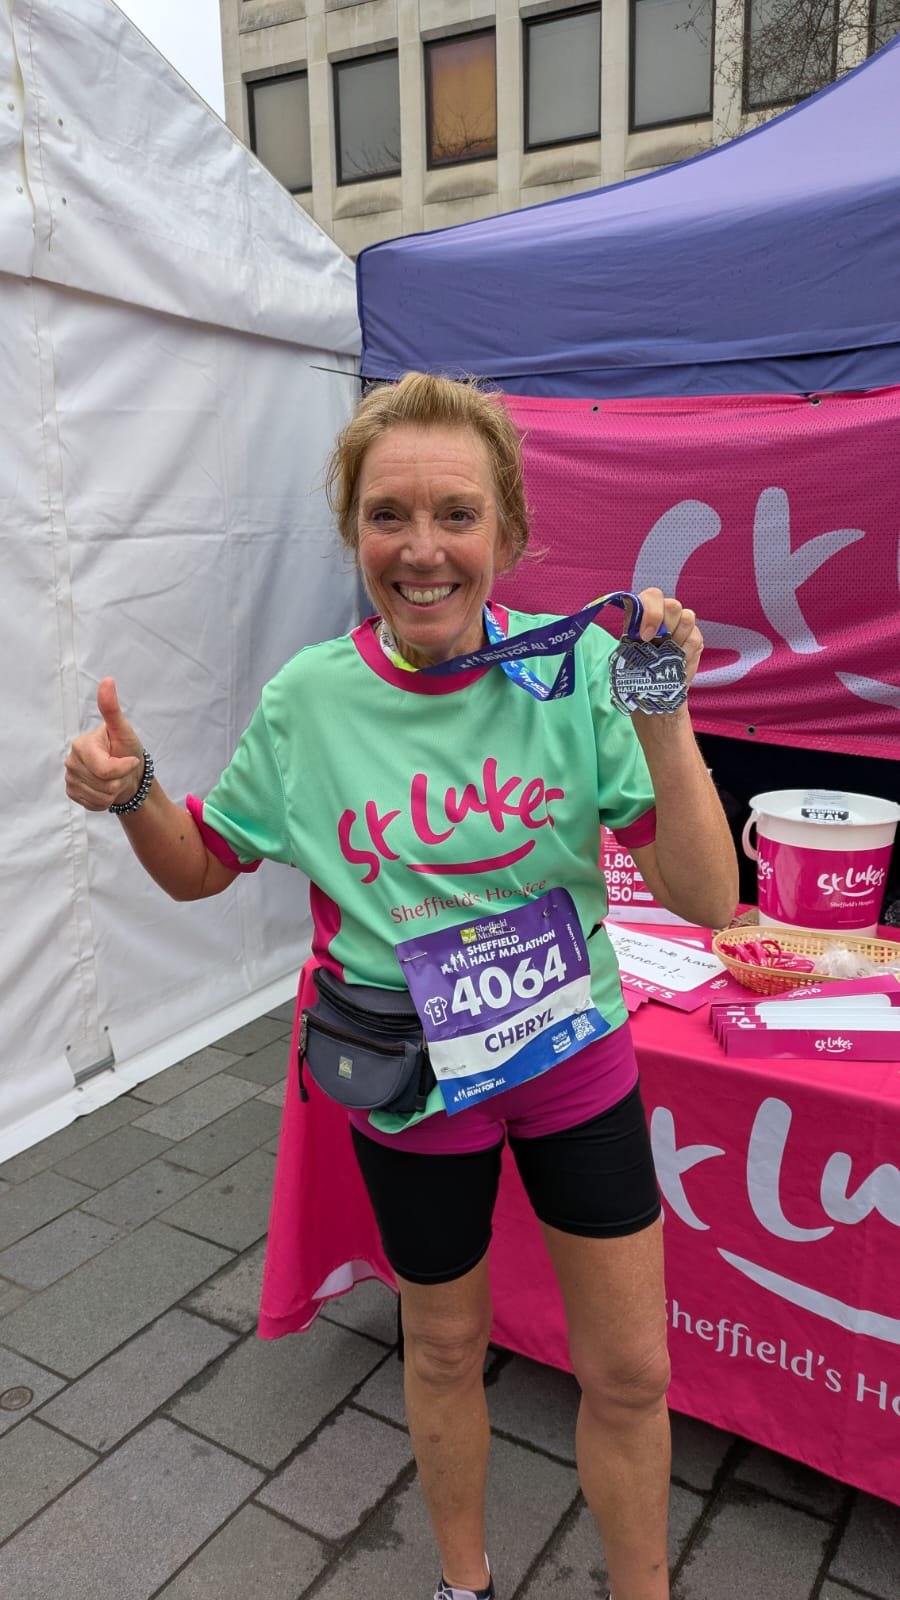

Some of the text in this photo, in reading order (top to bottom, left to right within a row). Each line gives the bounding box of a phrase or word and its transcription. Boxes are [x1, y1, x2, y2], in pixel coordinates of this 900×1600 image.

[631, 486, 866, 687] St
[483, 652, 506, 663] RUN
[507, 645, 530, 657] FOR
[531, 642, 549, 650] ALL
[548, 629, 577, 645] 2025
[616, 678, 651, 686] SHEFFIELD
[637, 683, 679, 692] MARATHON
[338, 800, 401, 884] St
[604, 853, 637, 869] 1,80
[817, 873, 844, 895] St
[390, 893, 482, 924] Sheffield's
[475, 918, 507, 932] Sheffield
[467, 935, 519, 956] SHEFFIELD
[470, 952, 496, 966] HALF
[499, 929, 556, 958] MARATHON
[683, 956, 717, 969] have
[451, 944, 566, 1017] 4064
[620, 974, 676, 999] UKE'S
[435, 1005, 441, 1017] S
[484, 1008, 554, 1053] CHERYL
[815, 1040, 826, 1051] St
[466, 1088, 481, 1098] RUN
[482, 1082, 494, 1092] FOR
[495, 1077, 506, 1087] ALL
[665, 1299, 842, 1393] heffield's
